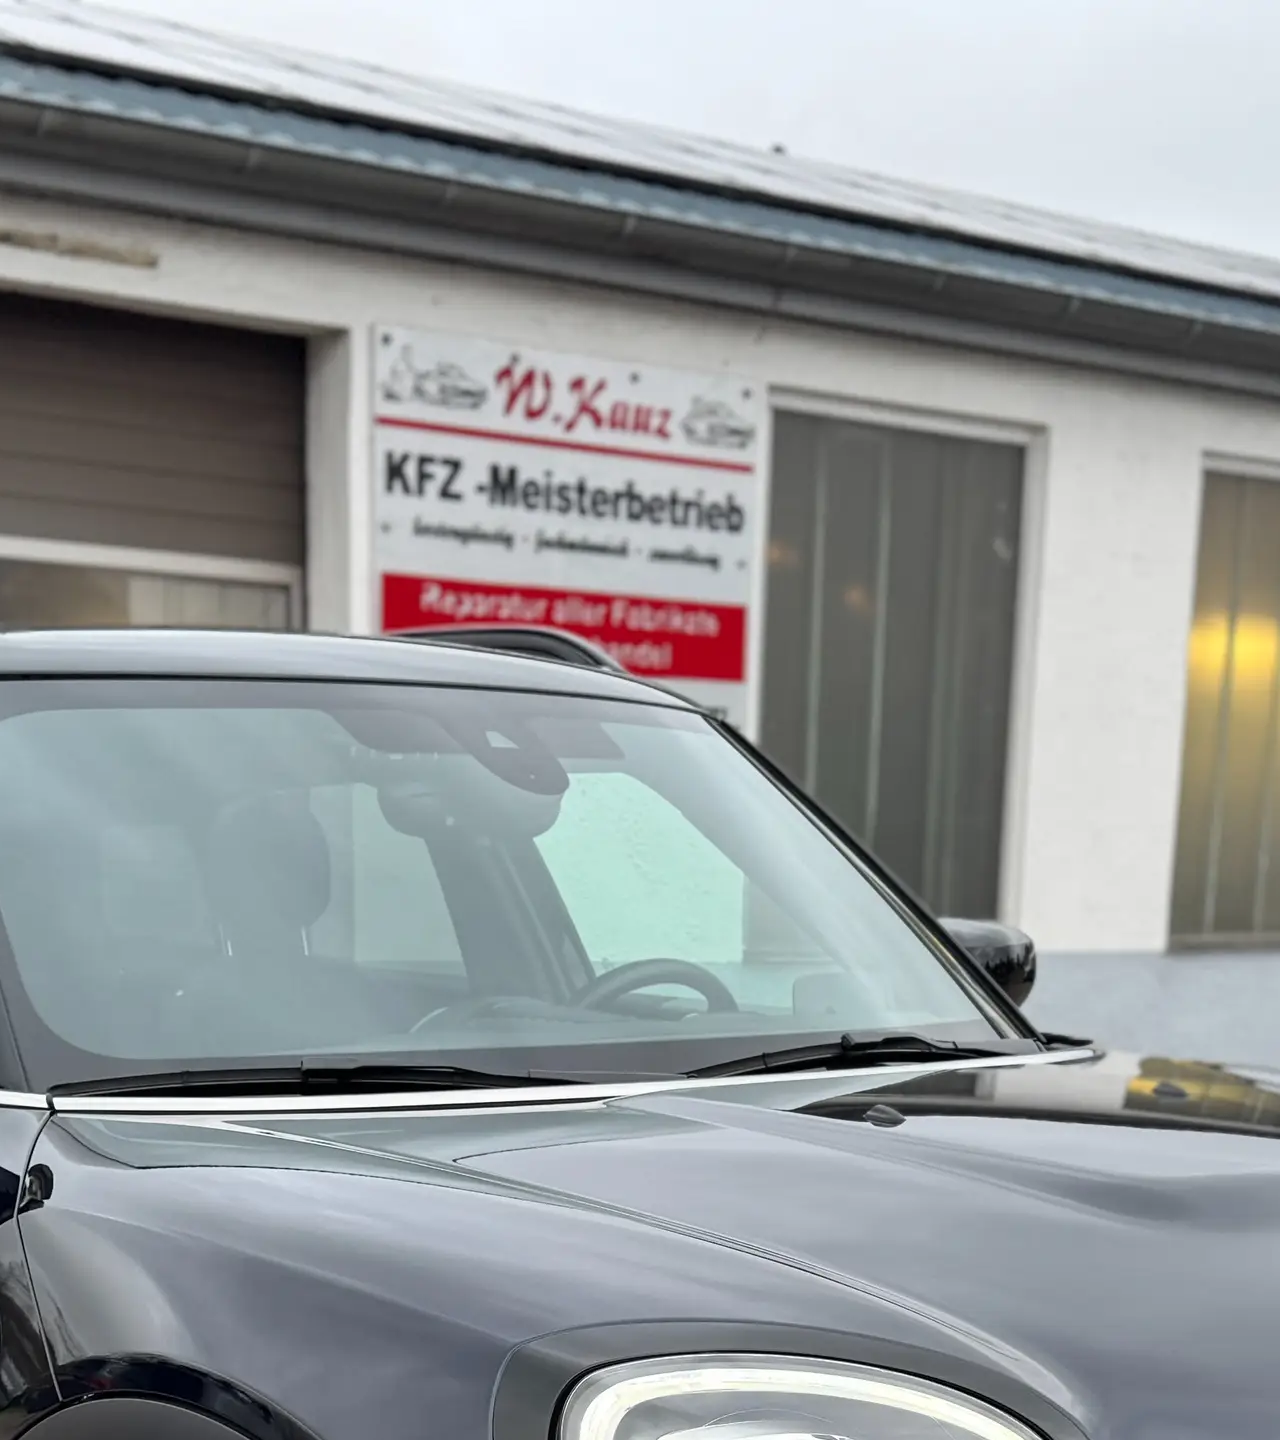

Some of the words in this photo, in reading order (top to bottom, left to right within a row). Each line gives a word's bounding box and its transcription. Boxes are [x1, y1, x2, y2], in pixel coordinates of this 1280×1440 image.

[384, 449, 463, 502] KFZ
[418, 581, 547, 623] Reparatur
[550, 594, 608, 630] aller
[610, 598, 722, 638] Fabrikate
